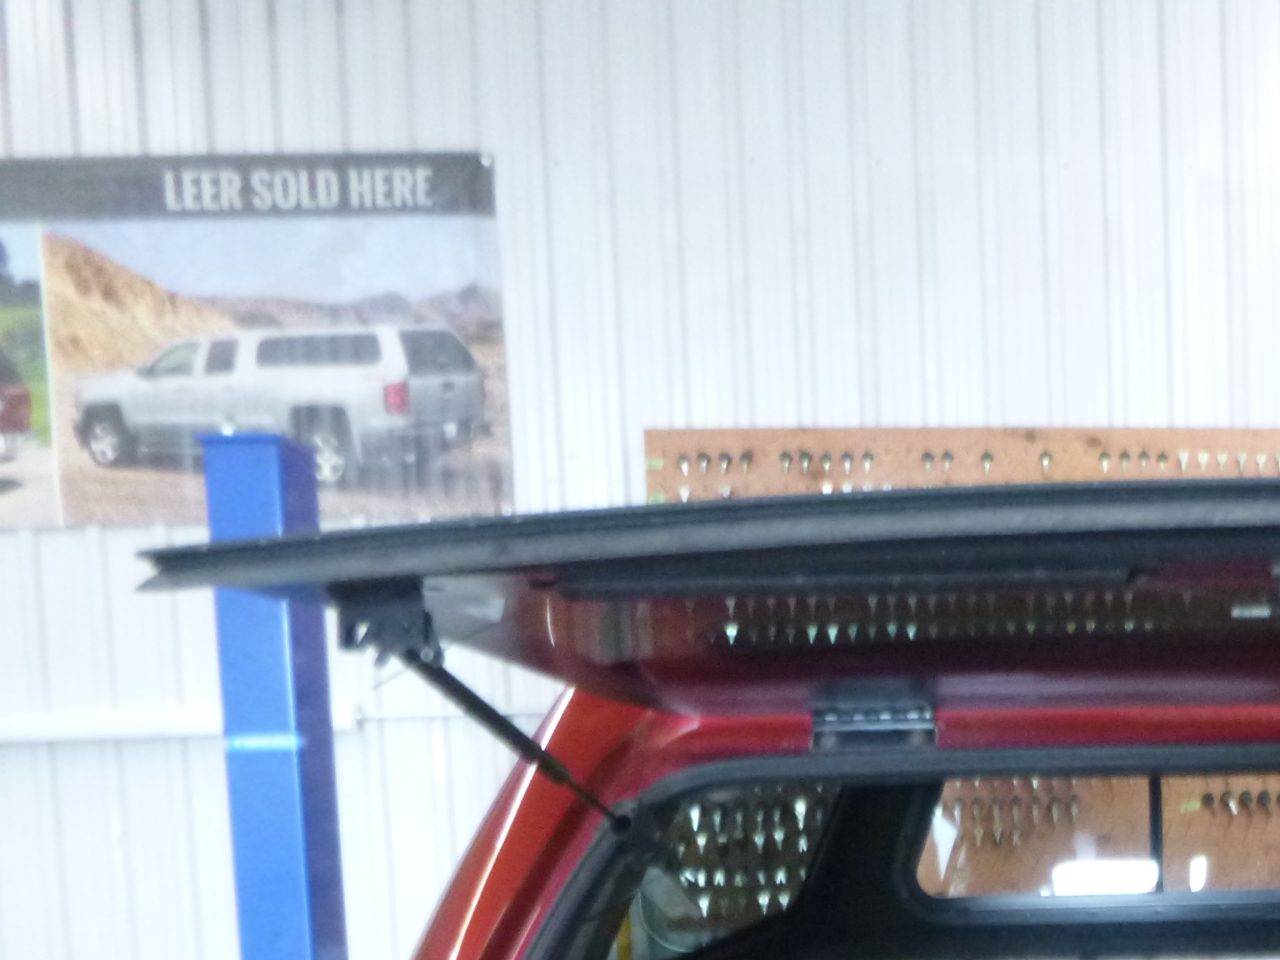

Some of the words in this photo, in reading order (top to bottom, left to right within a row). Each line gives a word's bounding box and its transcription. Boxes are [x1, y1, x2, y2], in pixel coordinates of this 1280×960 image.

[164, 168, 243, 211] LEER
[251, 168, 340, 210] SOLD
[350, 166, 434, 208] HERE
